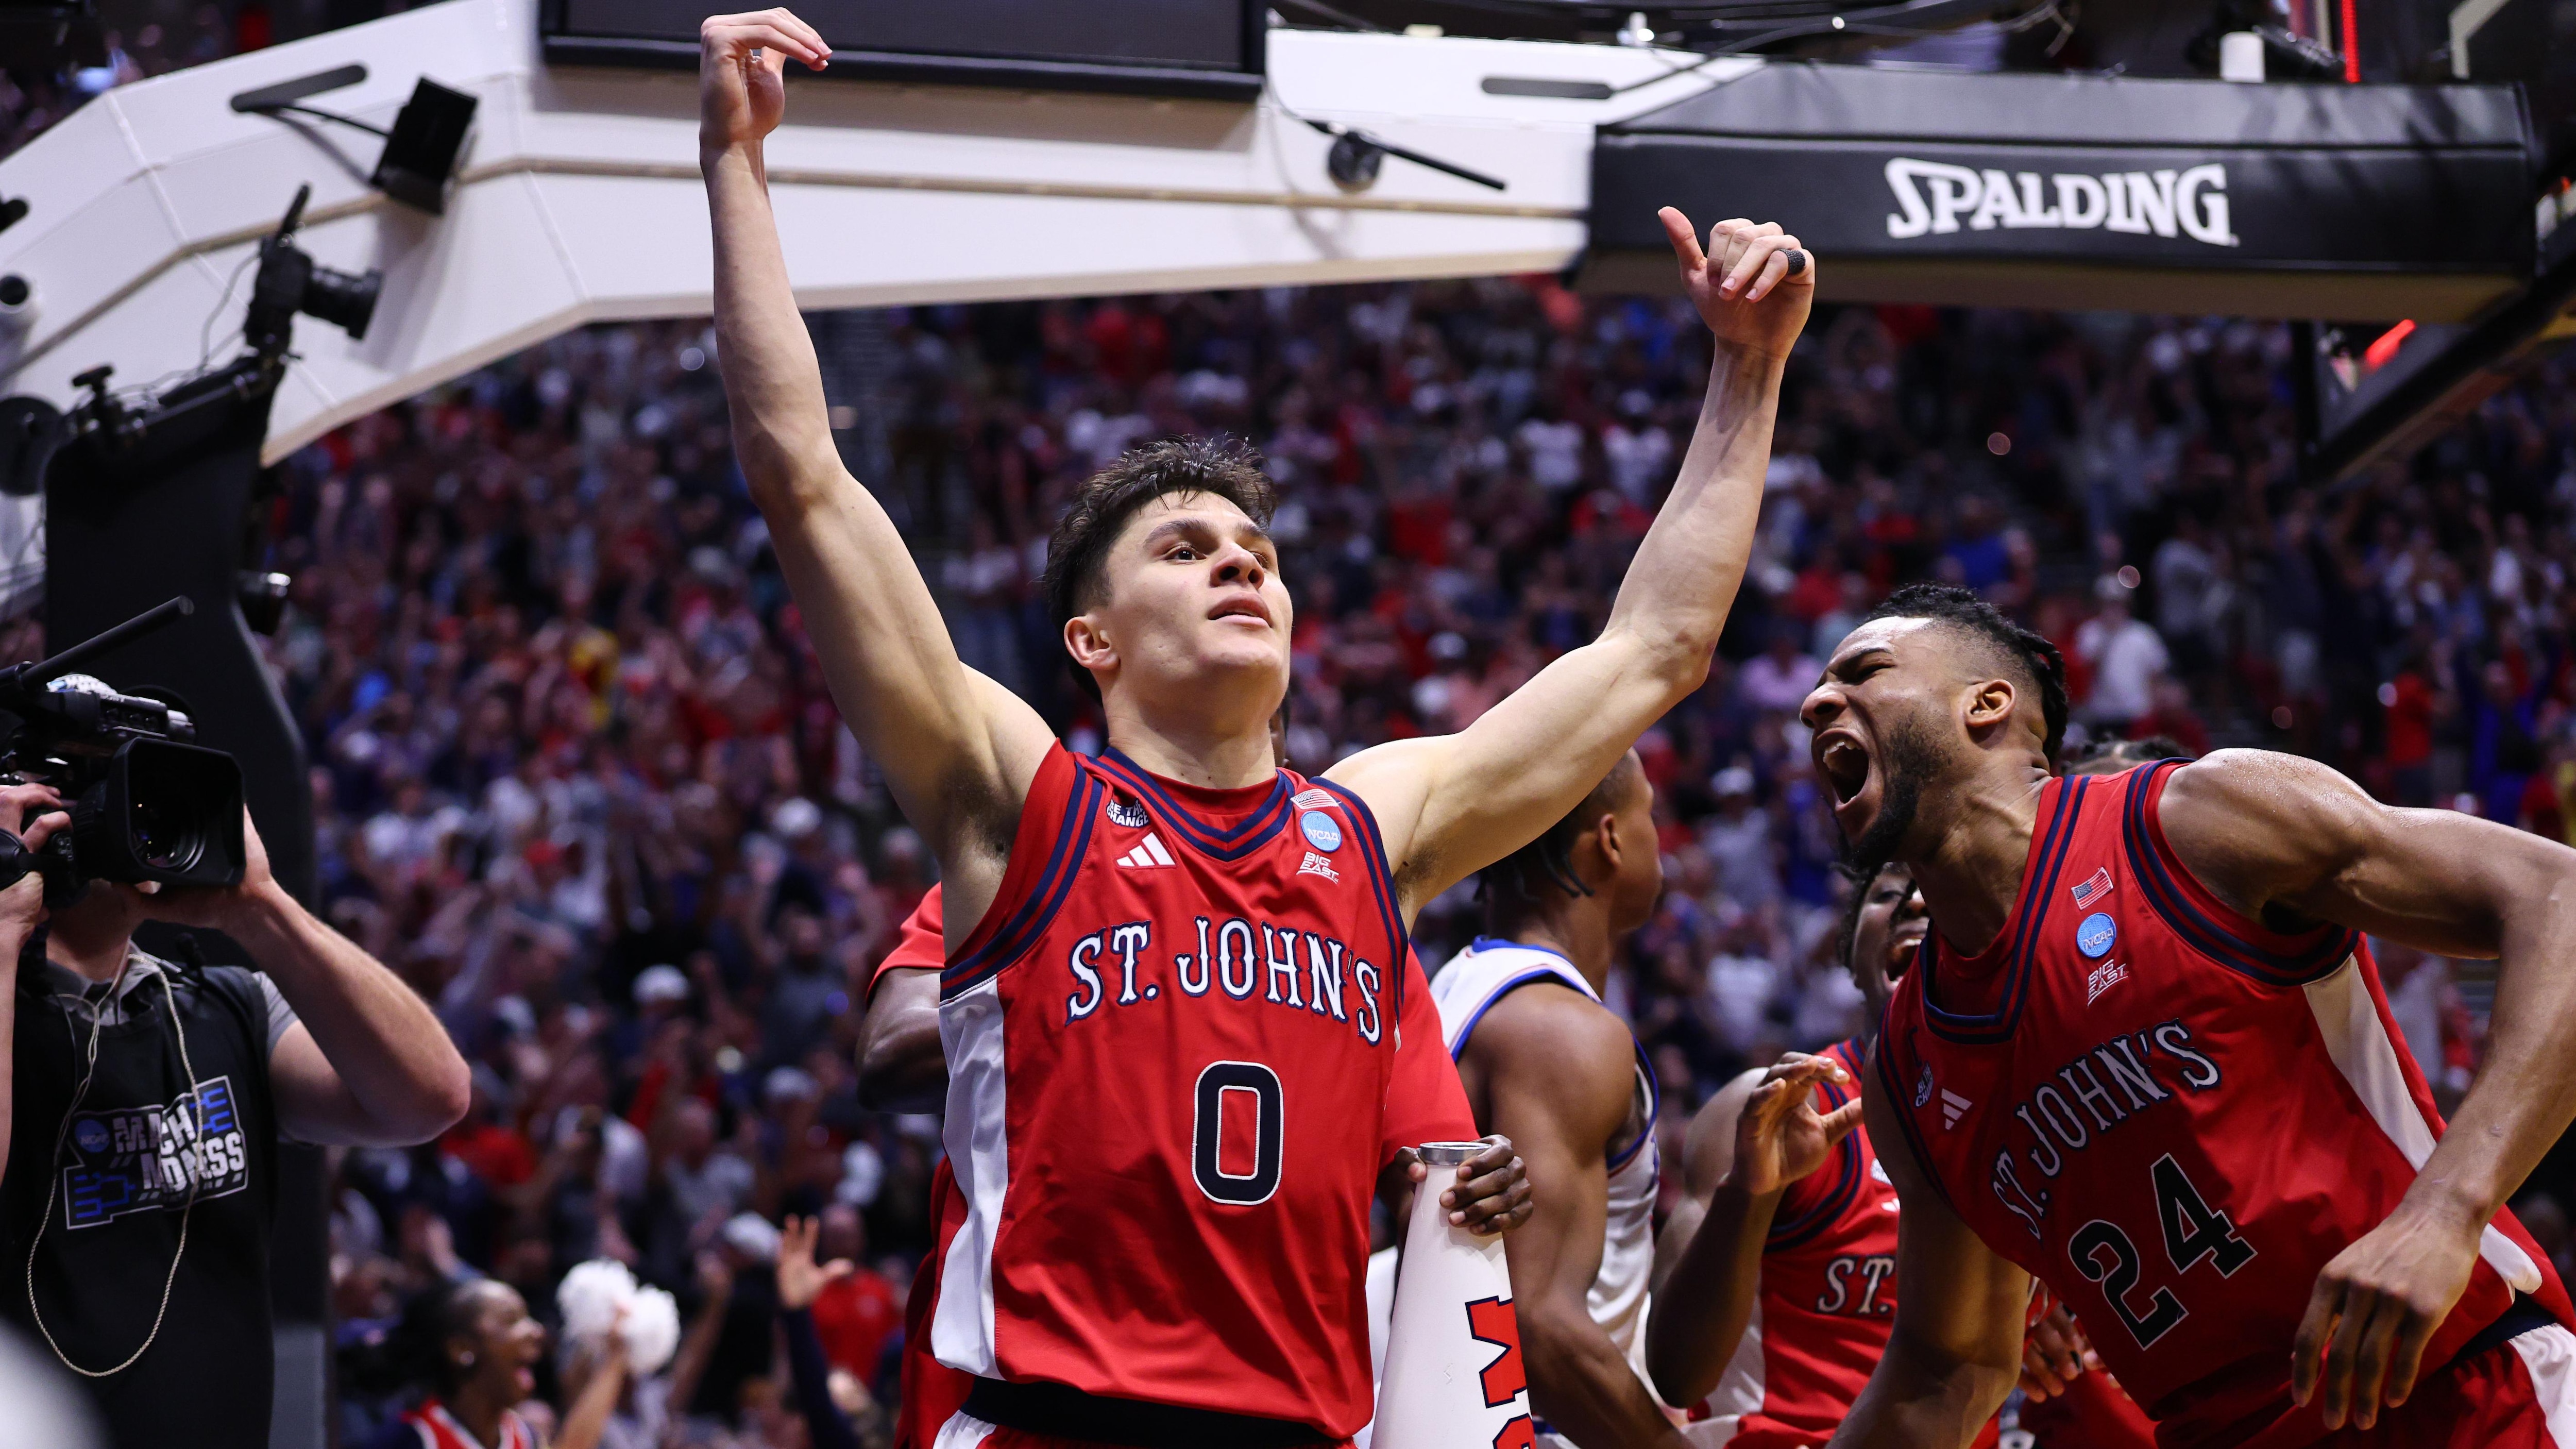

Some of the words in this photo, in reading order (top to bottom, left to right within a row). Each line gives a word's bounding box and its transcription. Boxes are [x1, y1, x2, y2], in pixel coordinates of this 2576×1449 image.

[1884, 157, 2233, 247] SPALDING
[1107, 805, 1149, 827] CHANGE
[1110, 799, 1122, 815] BE
[1125, 800, 1143, 817] THE
[1307, 828, 1340, 843] NCAA
[1299, 861, 1340, 880] EAST
[1303, 851, 1331, 867] BIG
[2084, 928, 2114, 951] NCAA
[1065, 920, 1160, 1025] ST.
[1174, 915, 1381, 1046] JOHN'S
[2088, 959, 2114, 987] BIG
[2088, 963, 2126, 1000] EAST
[2015, 1018, 2222, 1177] JOHN'S
[1192, 1060, 1284, 1205] 0
[1992, 1143, 2050, 1242] ST.
[2067, 1152, 2258, 1351] 24
[1816, 1254, 1896, 1315] ST.
